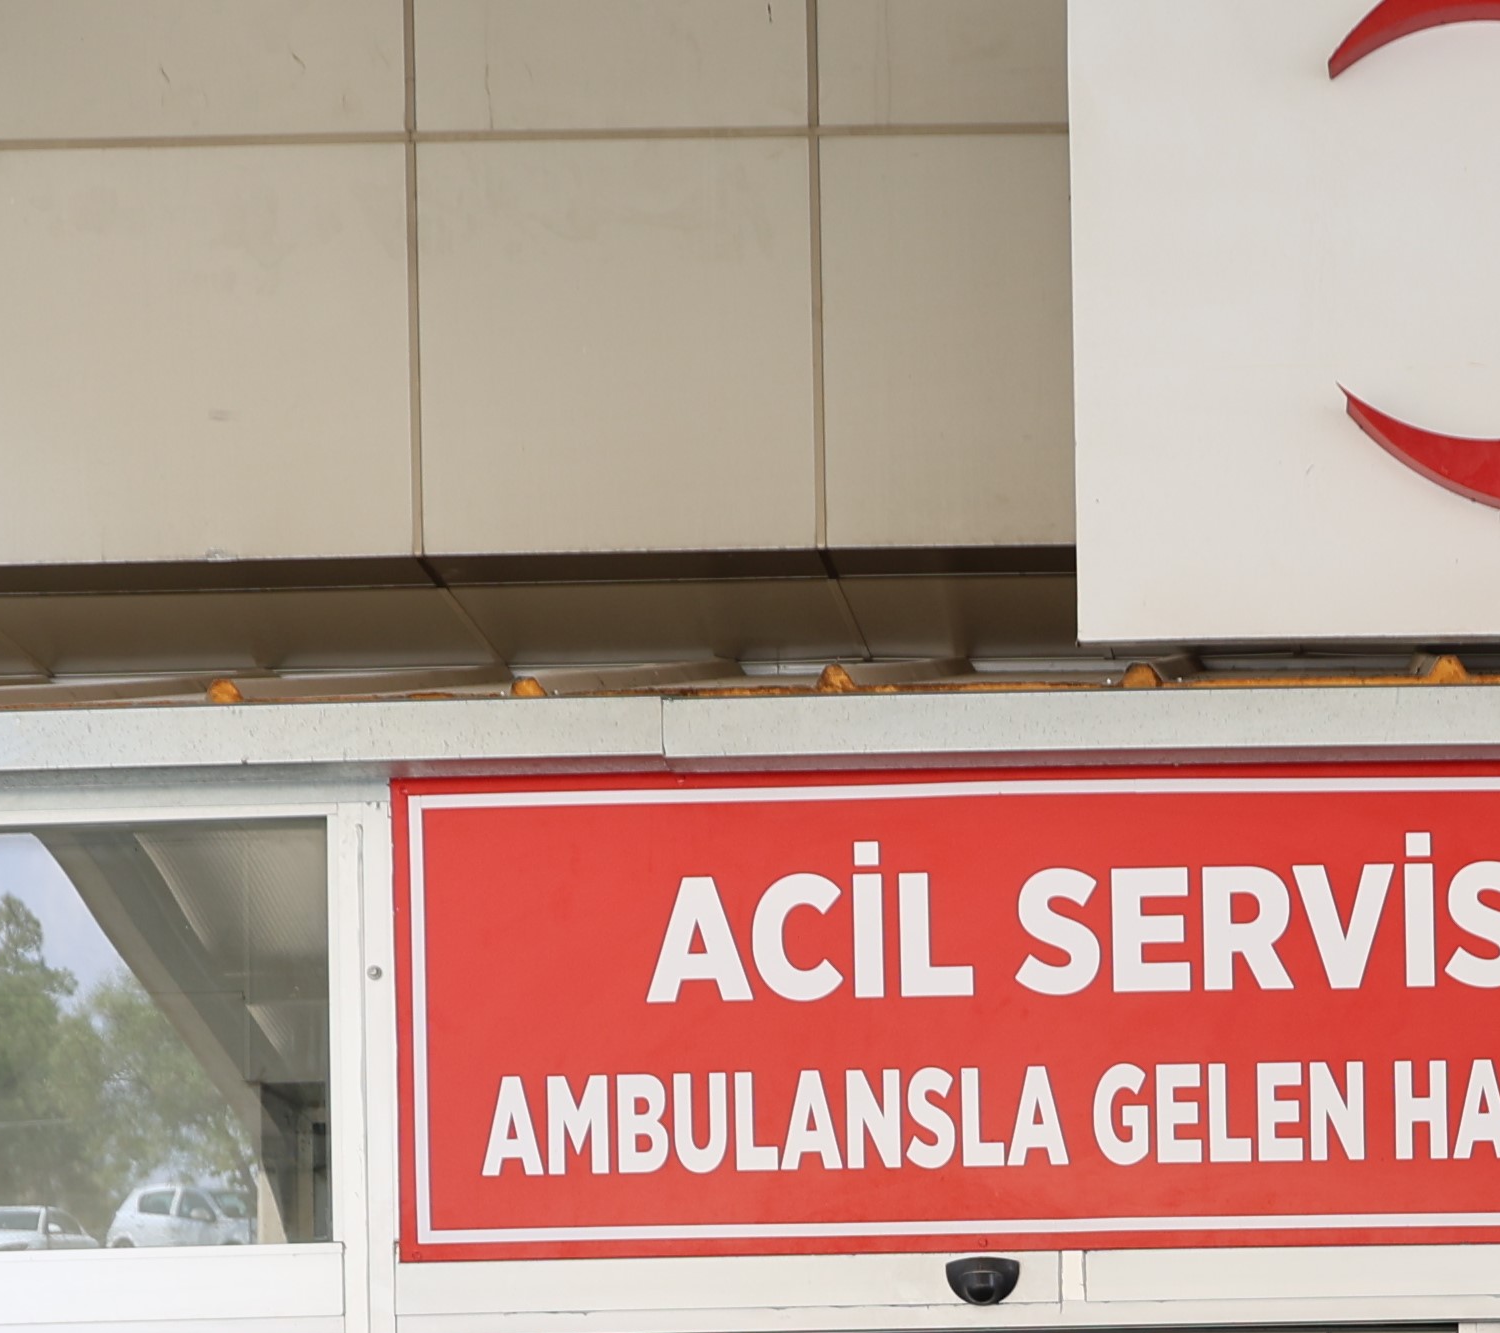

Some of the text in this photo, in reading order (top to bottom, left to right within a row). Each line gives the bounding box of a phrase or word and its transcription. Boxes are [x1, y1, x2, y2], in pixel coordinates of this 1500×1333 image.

[645, 841, 975, 1003] ACİL
[481, 1065, 1070, 1177] AMBULANSLA
[1093, 1060, 1366, 1167] GELEN
